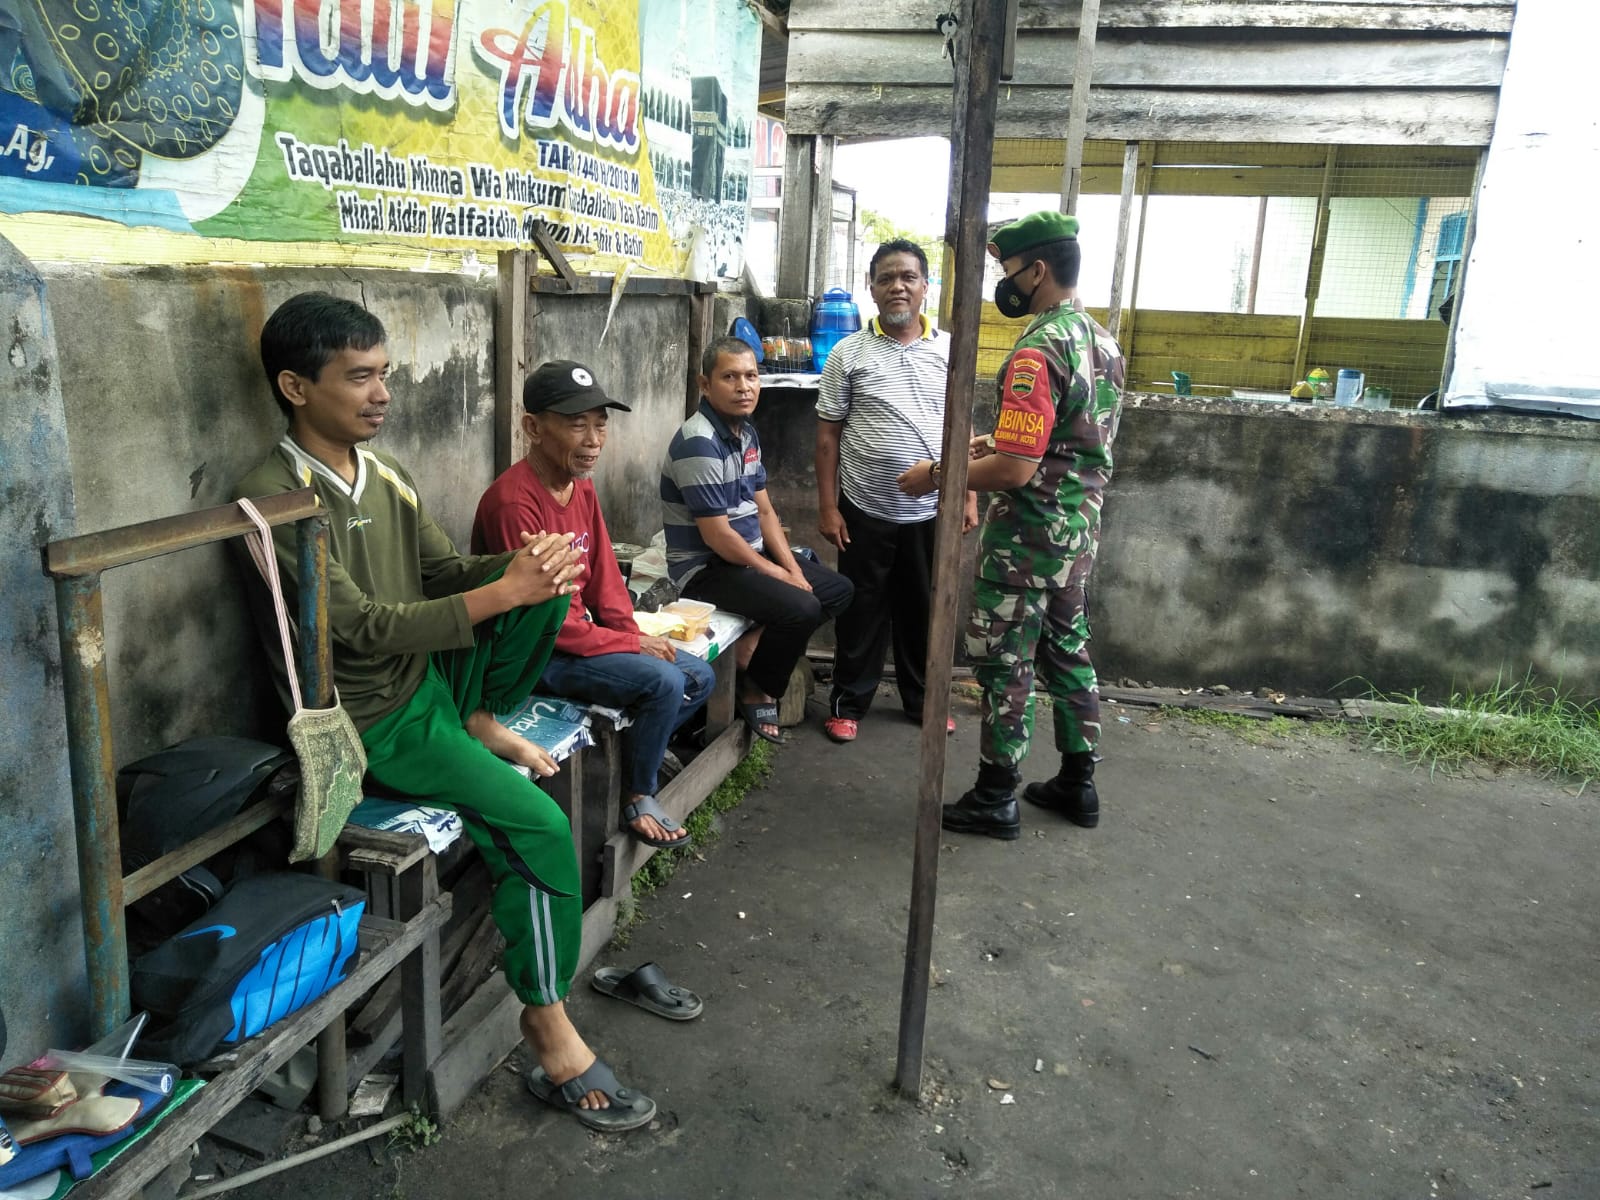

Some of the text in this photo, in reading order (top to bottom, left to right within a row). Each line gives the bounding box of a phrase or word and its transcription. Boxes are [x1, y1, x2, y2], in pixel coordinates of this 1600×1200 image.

[279, 137, 406, 188] Taqaballahu
[410, 158, 463, 195] Minna
[470, 166, 501, 198] Wa
[505, 171, 566, 209] Minkum
[619, 199, 635, 224] Yaa
[635, 203, 658, 230] Karim
[631, 172, 639, 194] M
[339, 195, 384, 230] Minal
[388, 200, 427, 233] Aidin
[522, 215, 570, 244] Mon
[615, 231, 622, 253] &
[623, 233, 643, 257] Batin
